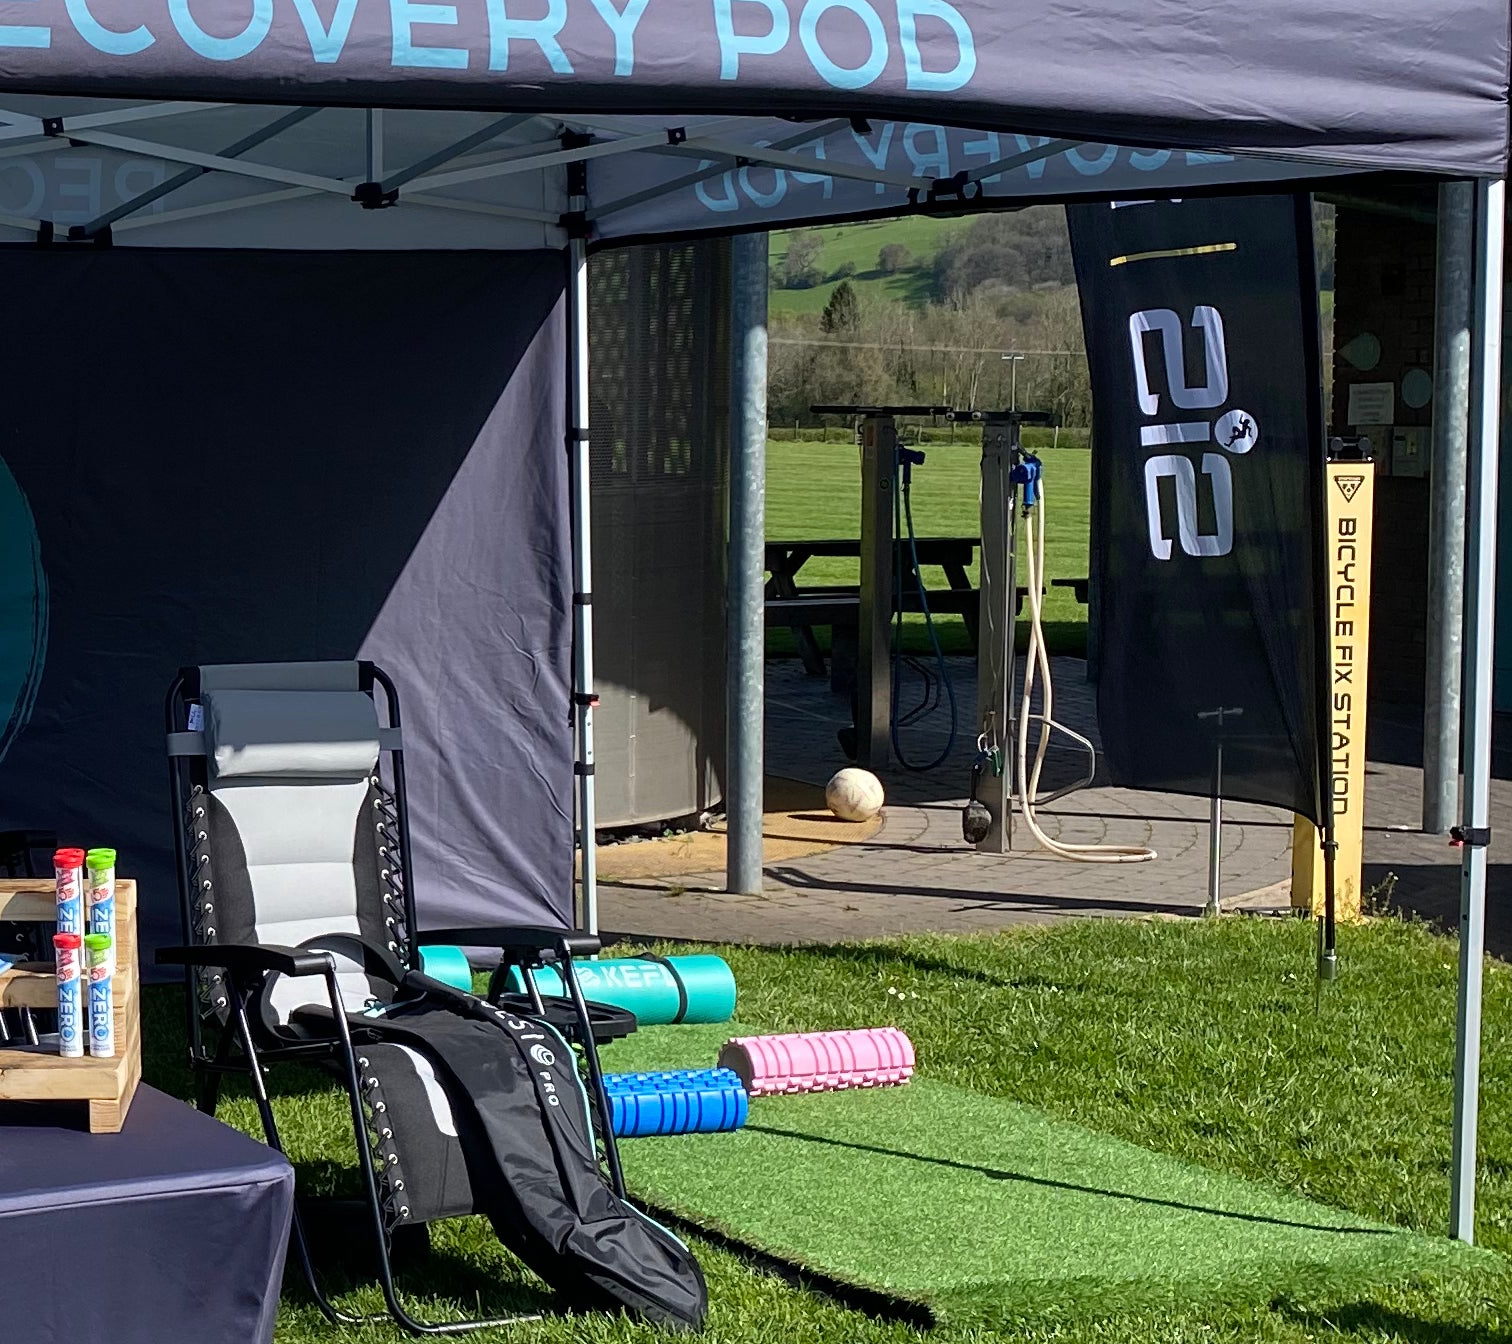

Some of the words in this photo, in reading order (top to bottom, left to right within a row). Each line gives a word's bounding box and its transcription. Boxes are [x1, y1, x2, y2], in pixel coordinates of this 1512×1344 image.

[1335, 517, 1356, 636] BICYCLE
[1334, 645, 1354, 684] FIX
[1332, 692, 1352, 815] STATION
[59, 988, 75, 1042] ZERO
[92, 987, 109, 1041] ZERO
[539, 1070, 560, 1107] PRO
